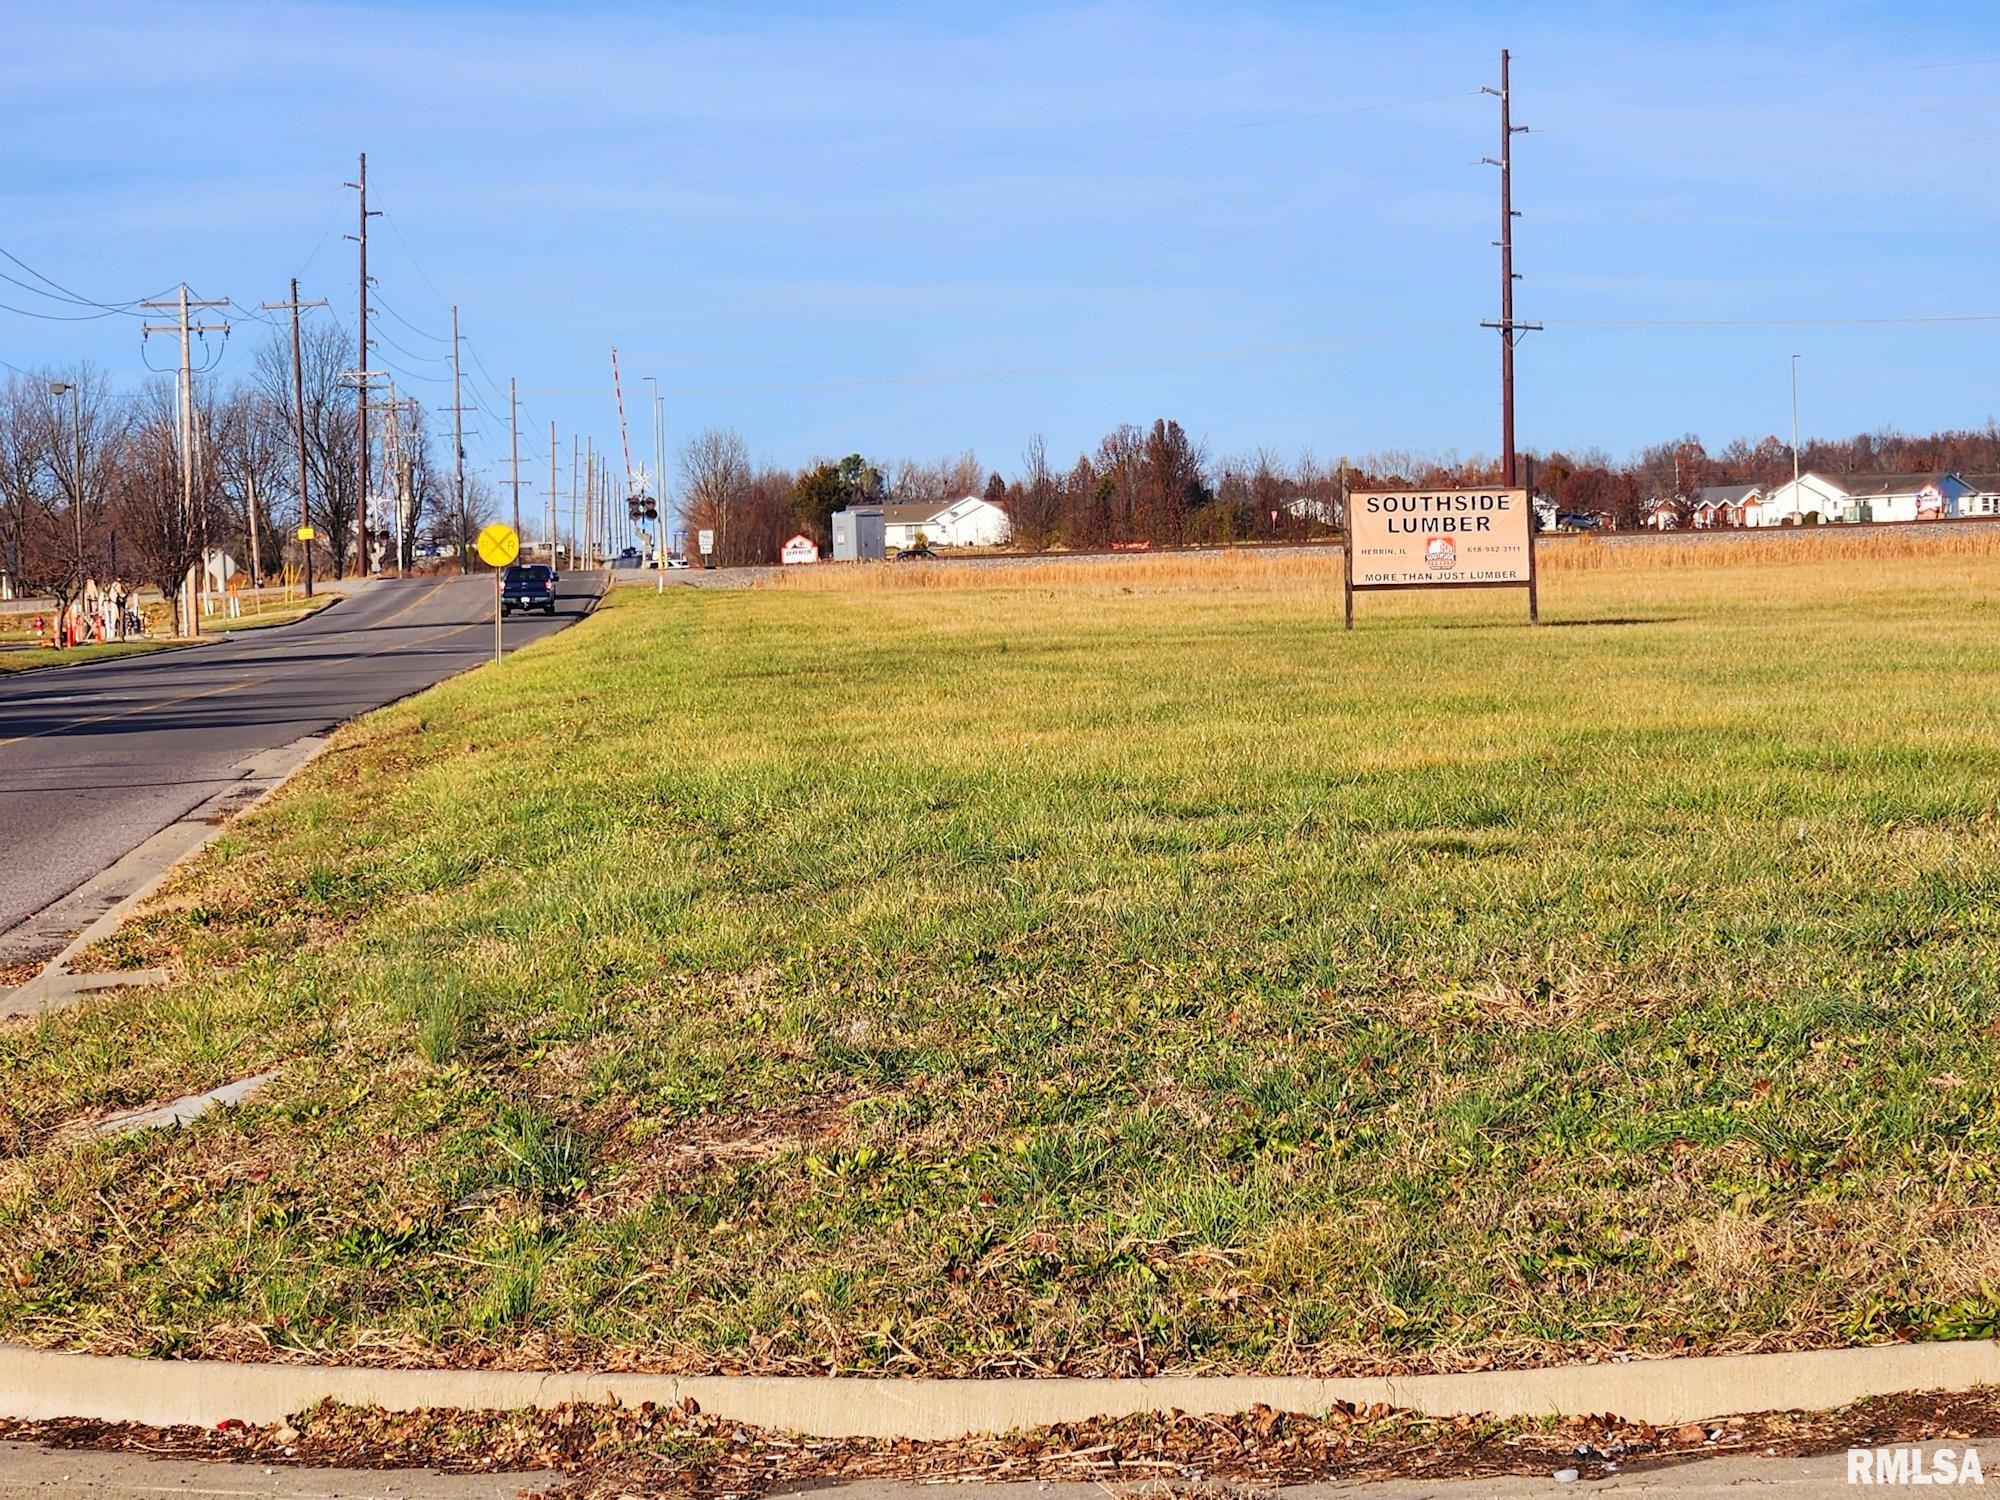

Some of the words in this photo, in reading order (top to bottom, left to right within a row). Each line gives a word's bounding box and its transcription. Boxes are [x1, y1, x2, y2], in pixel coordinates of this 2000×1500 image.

[1366, 495, 1510, 513] SOUTHSIDE
[1388, 516, 1491, 533] LUMBER
[1365, 573, 1397, 582] MORE
[1402, 572, 1433, 581] THAN
[1437, 571, 1466, 580] JUST
[1470, 570, 1517, 580] LUMBER
